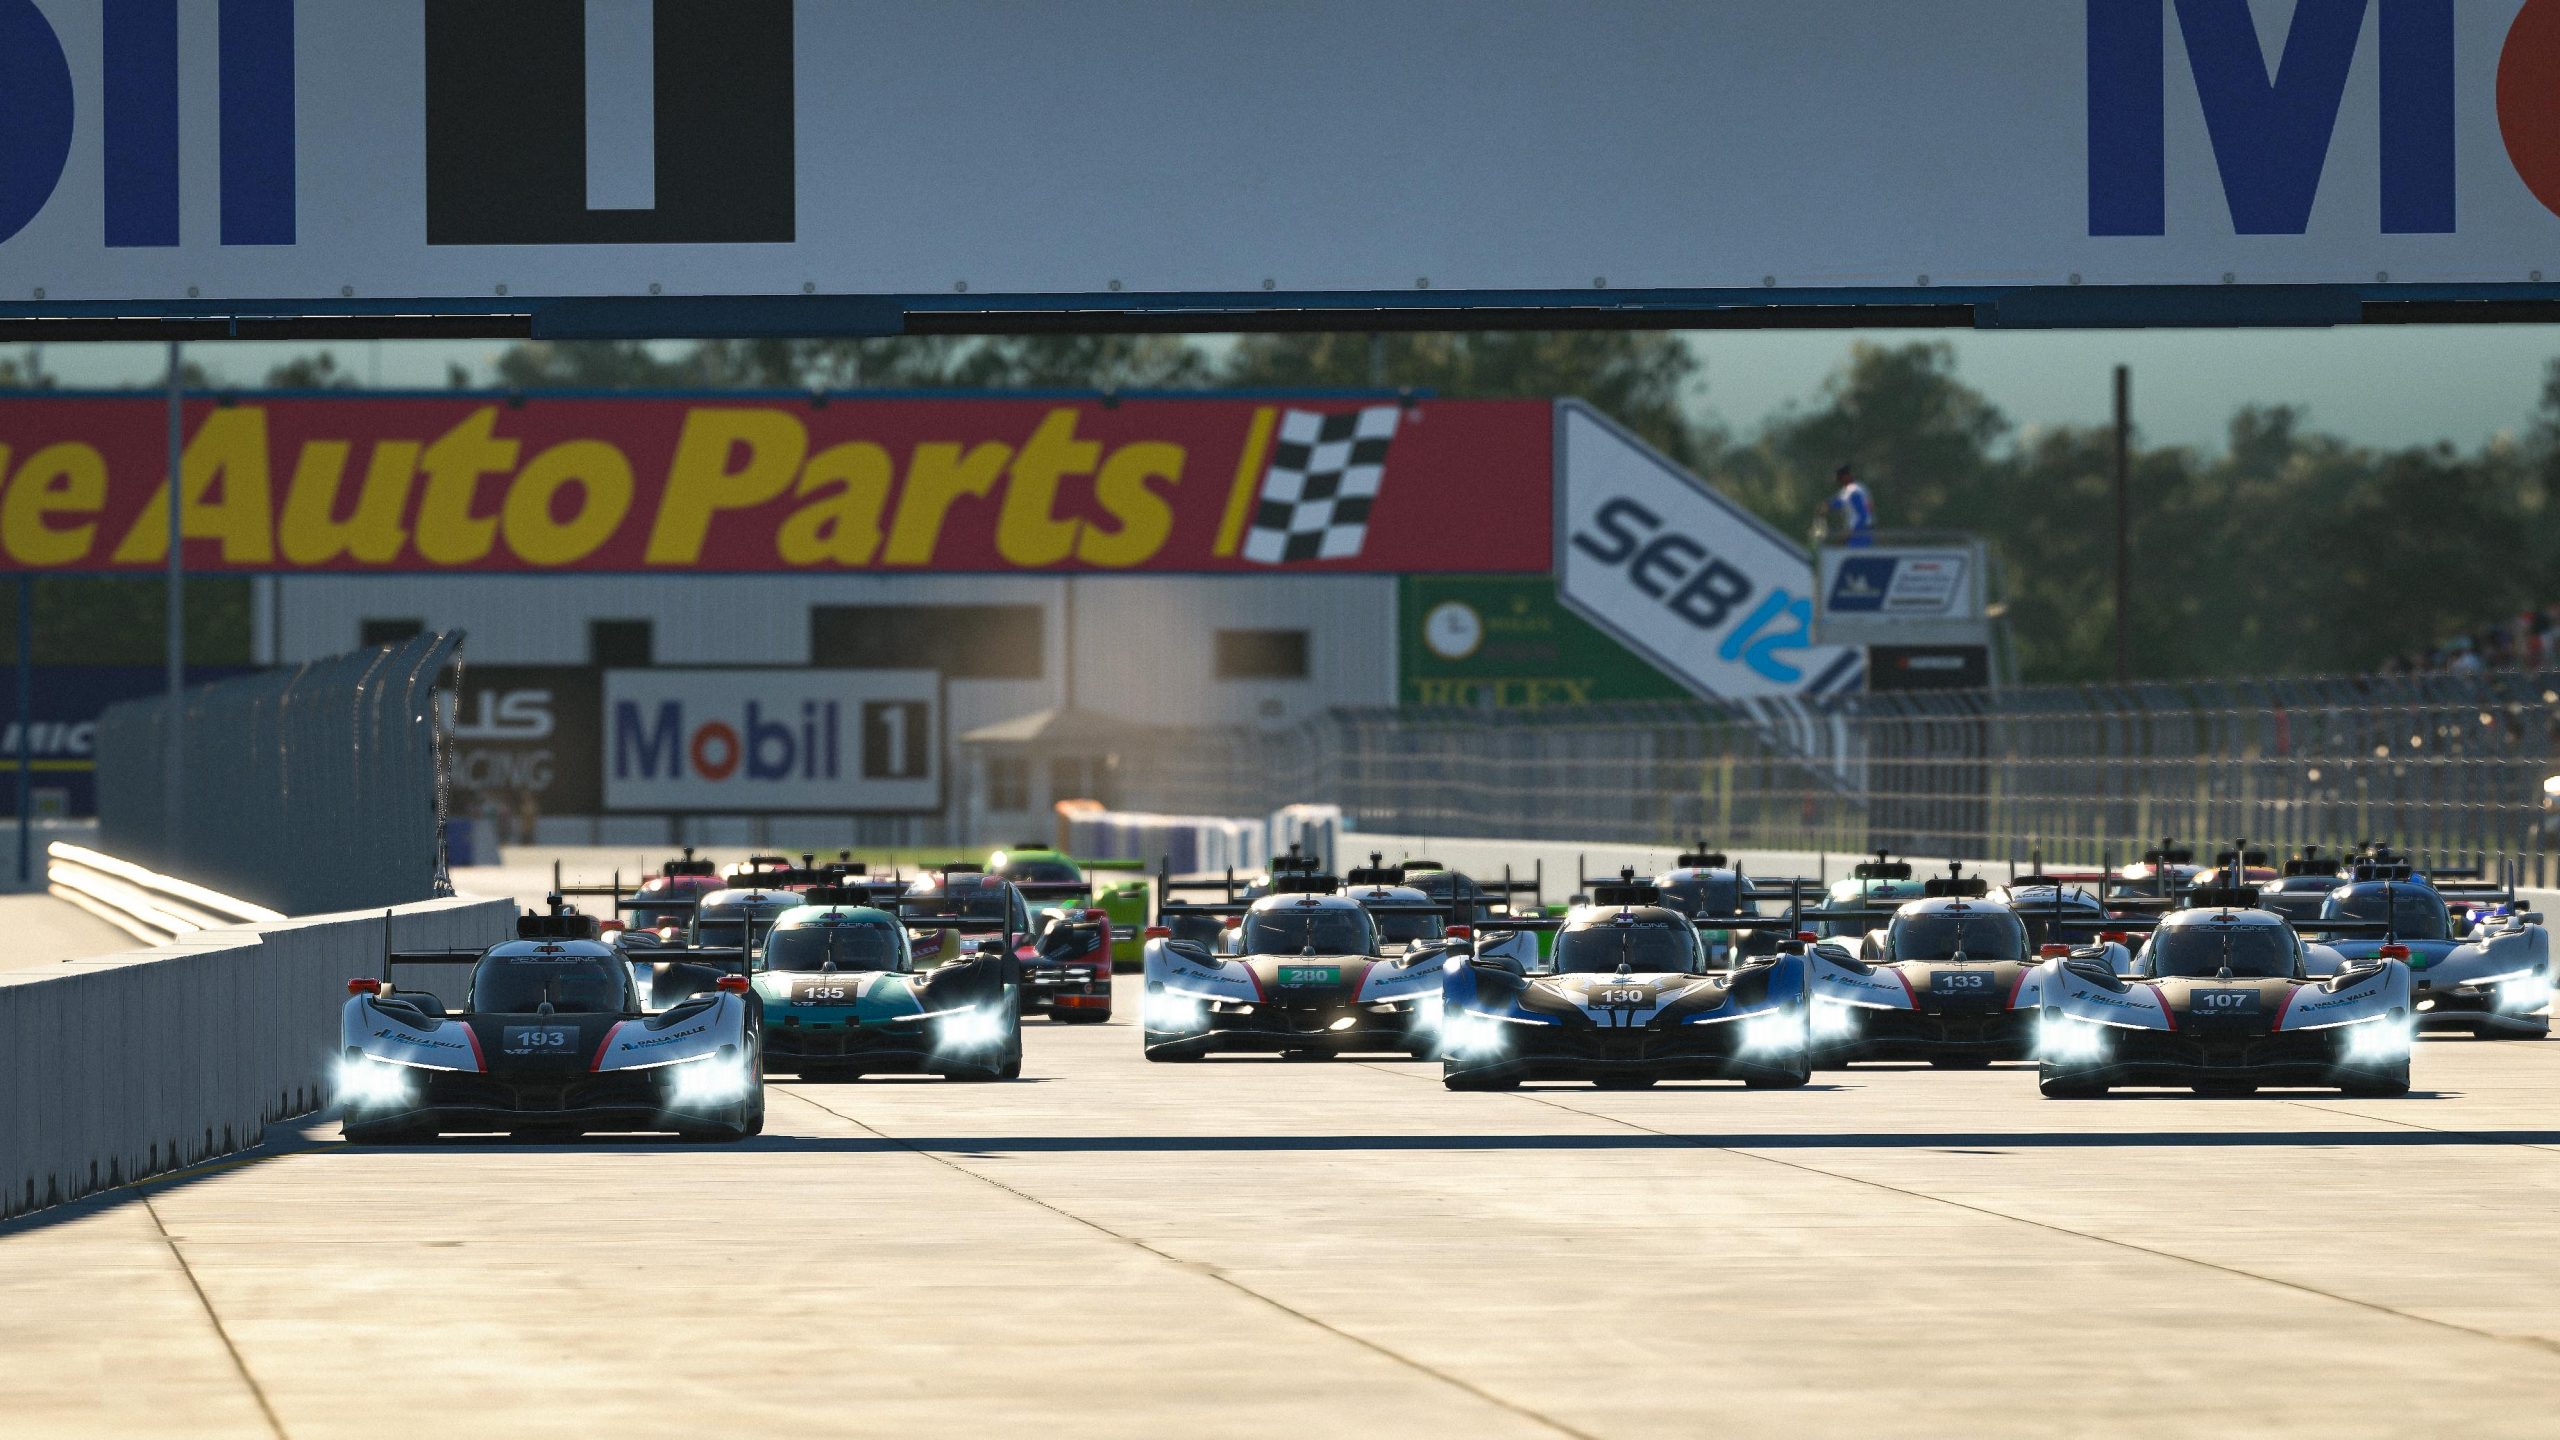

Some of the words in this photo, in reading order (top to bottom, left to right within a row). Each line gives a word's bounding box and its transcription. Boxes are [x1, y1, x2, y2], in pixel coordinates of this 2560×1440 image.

[2086, 0, 2560, 237] M
[0, 440, 107, 566] e
[112, 405, 634, 566] Auto
[643, 406, 1187, 567] Parts
[614, 700, 841, 781] Mobil
[881, 705, 908, 776] 1
[1291, 970, 1329, 981] 280
[1943, 975, 1983, 988] 133
[804, 987, 845, 999] 135
[1601, 990, 1643, 1002] 130
[2203, 994, 2247, 1007] 107
[517, 1032, 565, 1046] 193
[637, 1036, 671, 1045] DALLA
[673, 1025, 706, 1039] VALLE
